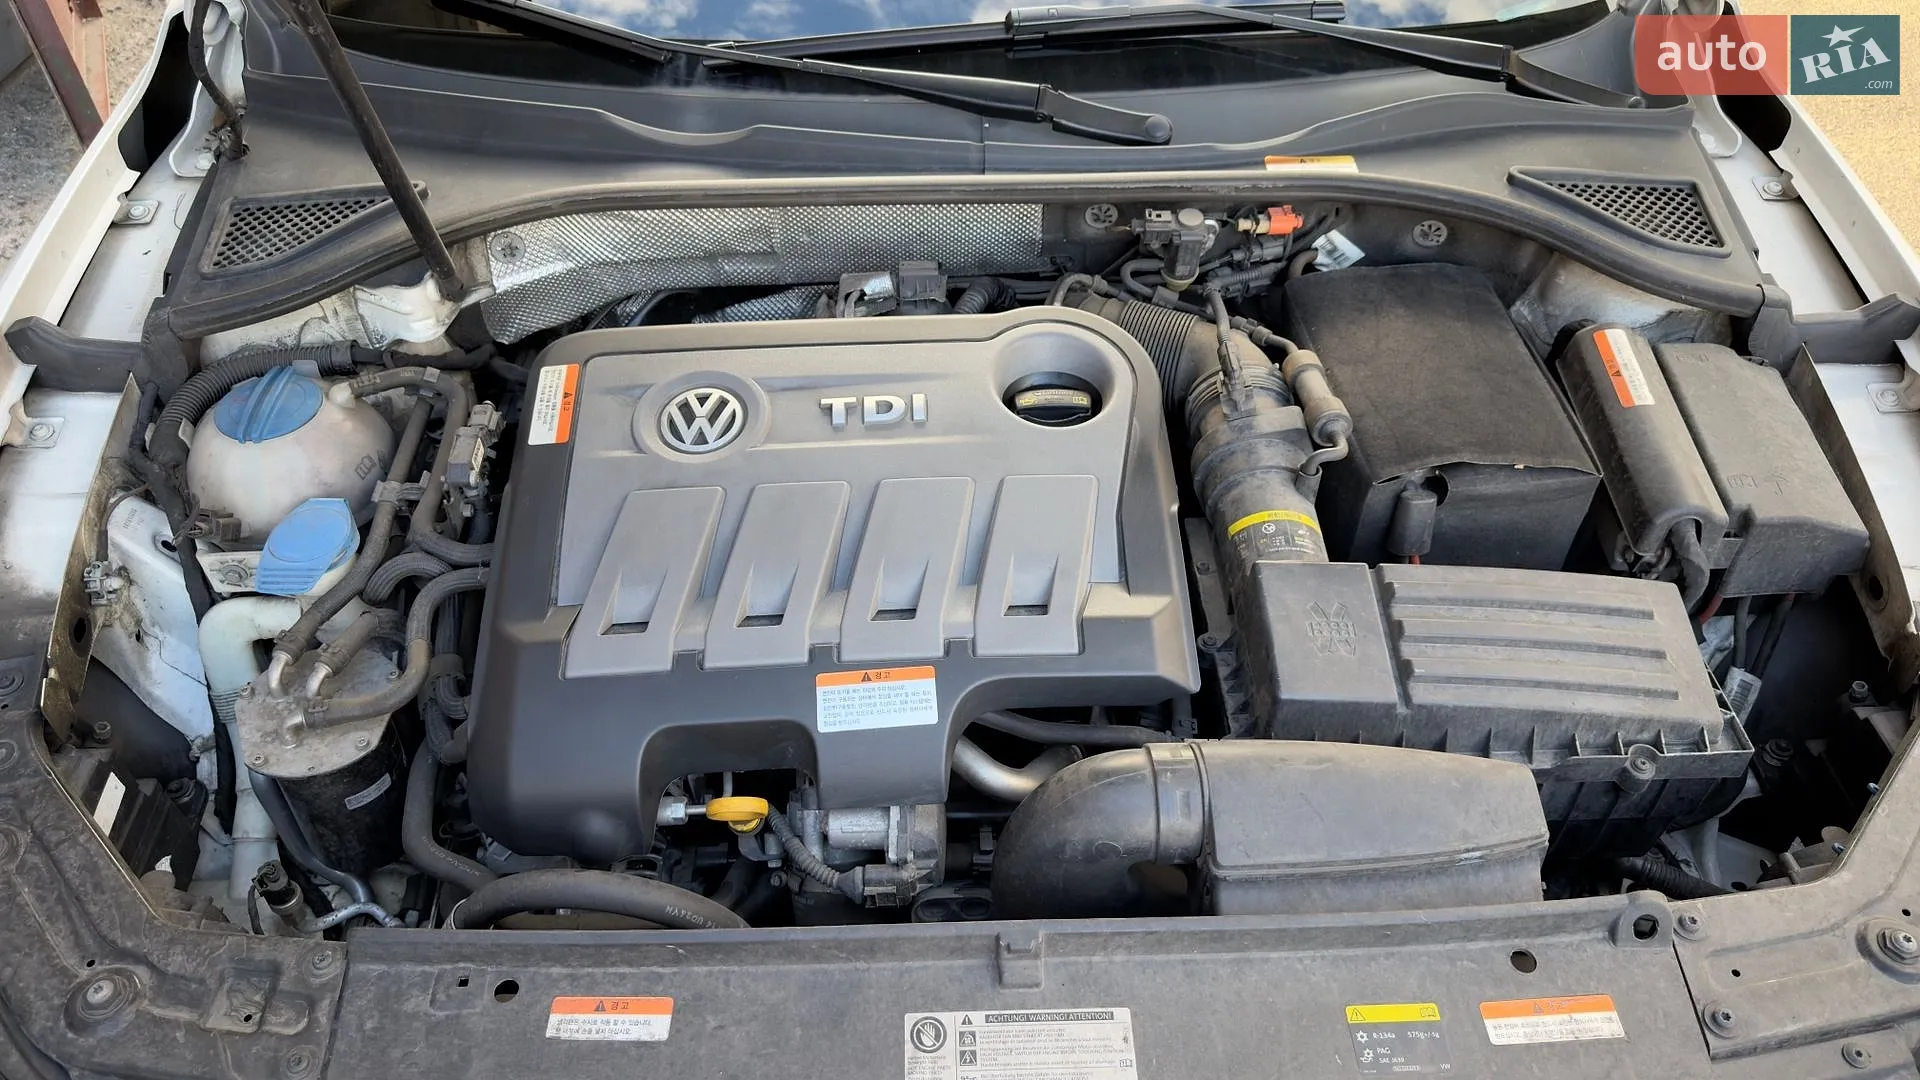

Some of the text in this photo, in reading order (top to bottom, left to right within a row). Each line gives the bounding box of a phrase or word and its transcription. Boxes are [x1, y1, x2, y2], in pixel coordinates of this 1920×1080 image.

[820, 393, 929, 429] TDI
[988, 1012, 1113, 1023] ACHTUNG! WARNING! ATTENTION!
